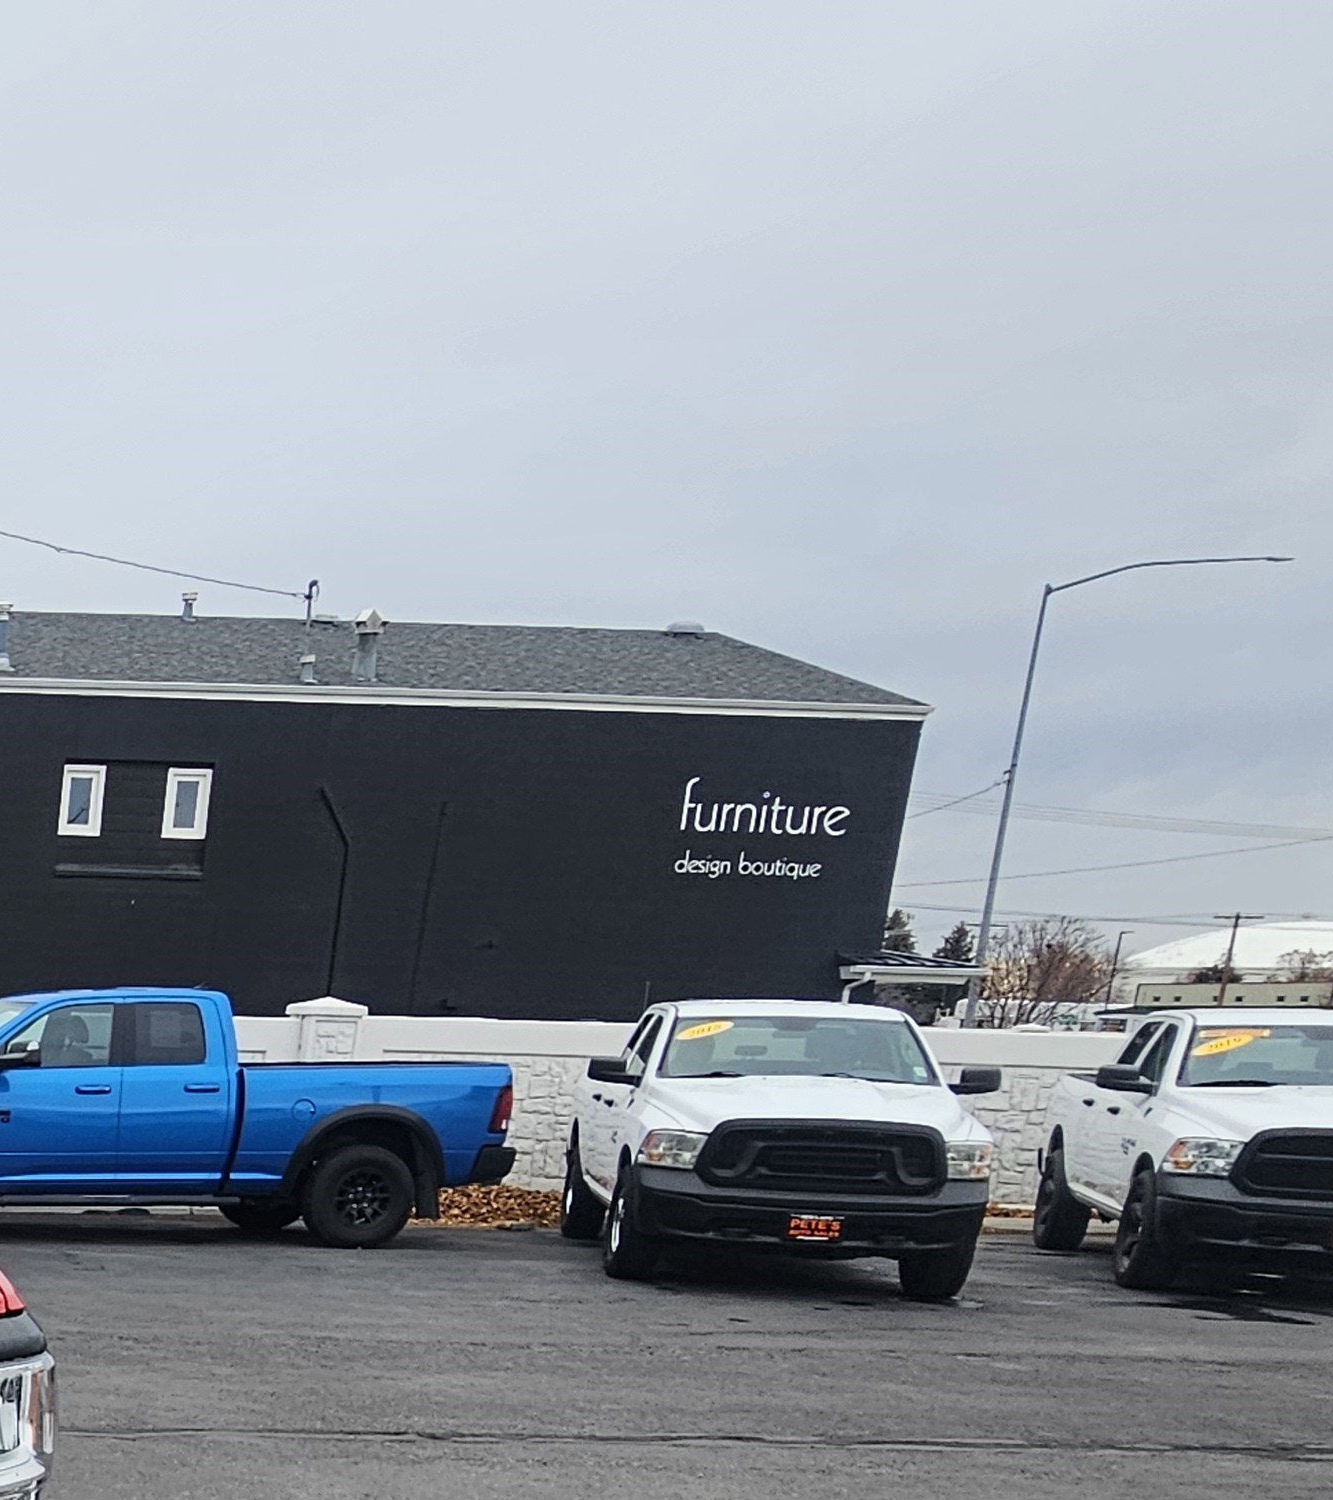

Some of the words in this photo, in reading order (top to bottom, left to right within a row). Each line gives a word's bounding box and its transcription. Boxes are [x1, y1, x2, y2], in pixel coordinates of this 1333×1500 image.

[679, 777, 850, 836] furniture
[674, 850, 730, 878] design
[738, 852, 822, 880] boutique
